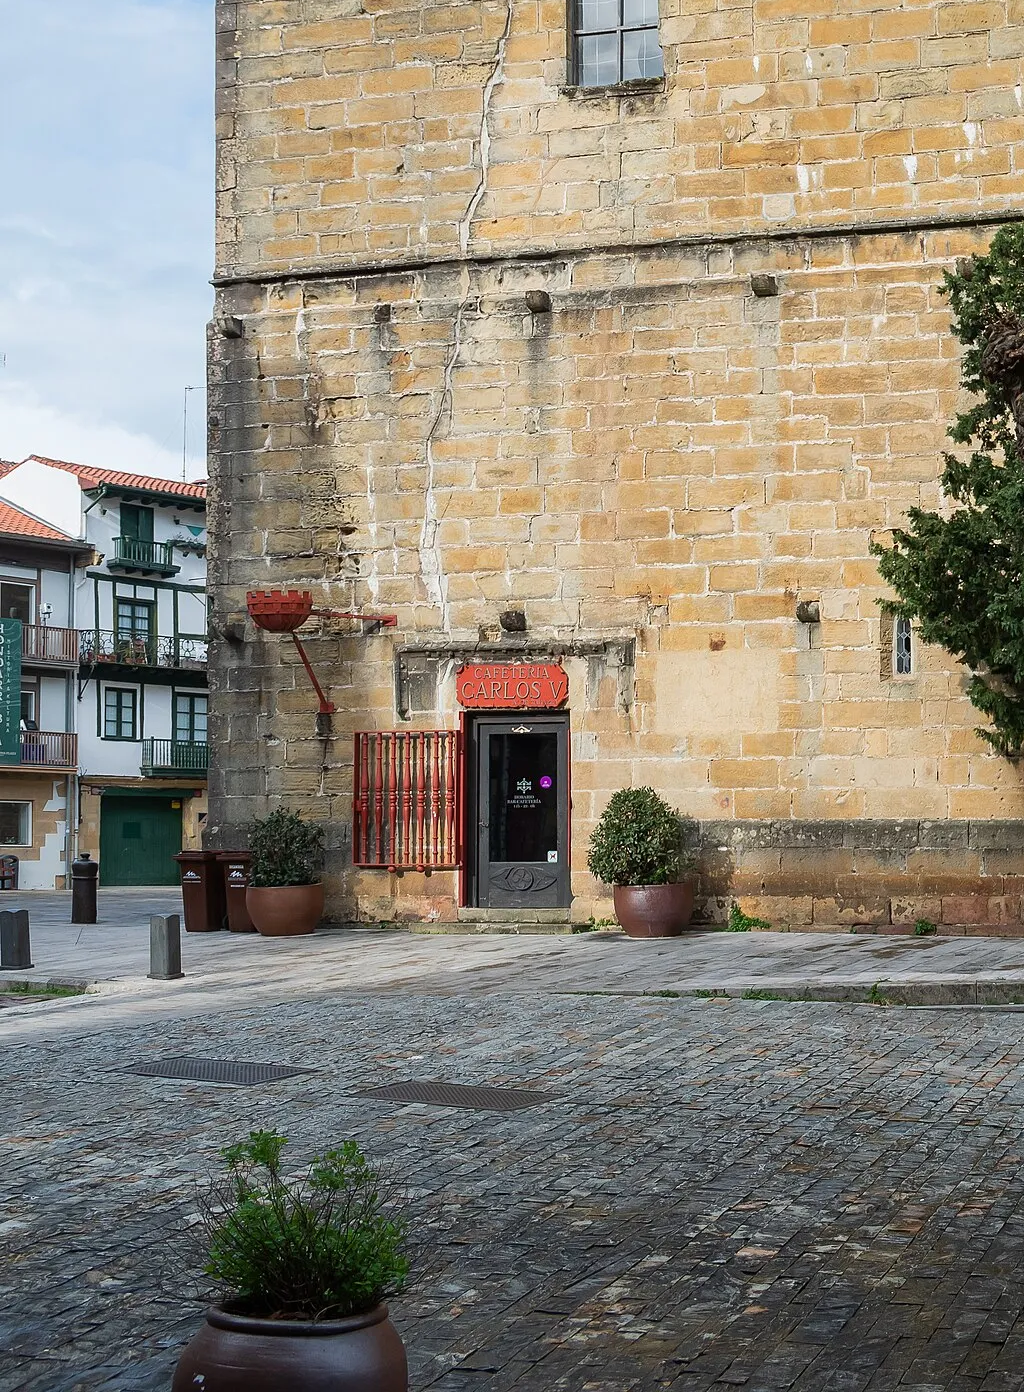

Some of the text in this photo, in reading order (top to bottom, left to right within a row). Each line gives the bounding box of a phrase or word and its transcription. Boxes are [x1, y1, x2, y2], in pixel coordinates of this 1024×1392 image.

[474, 667, 550, 680] CAFETERIA
[461, 681, 563, 700] CARLOS V
